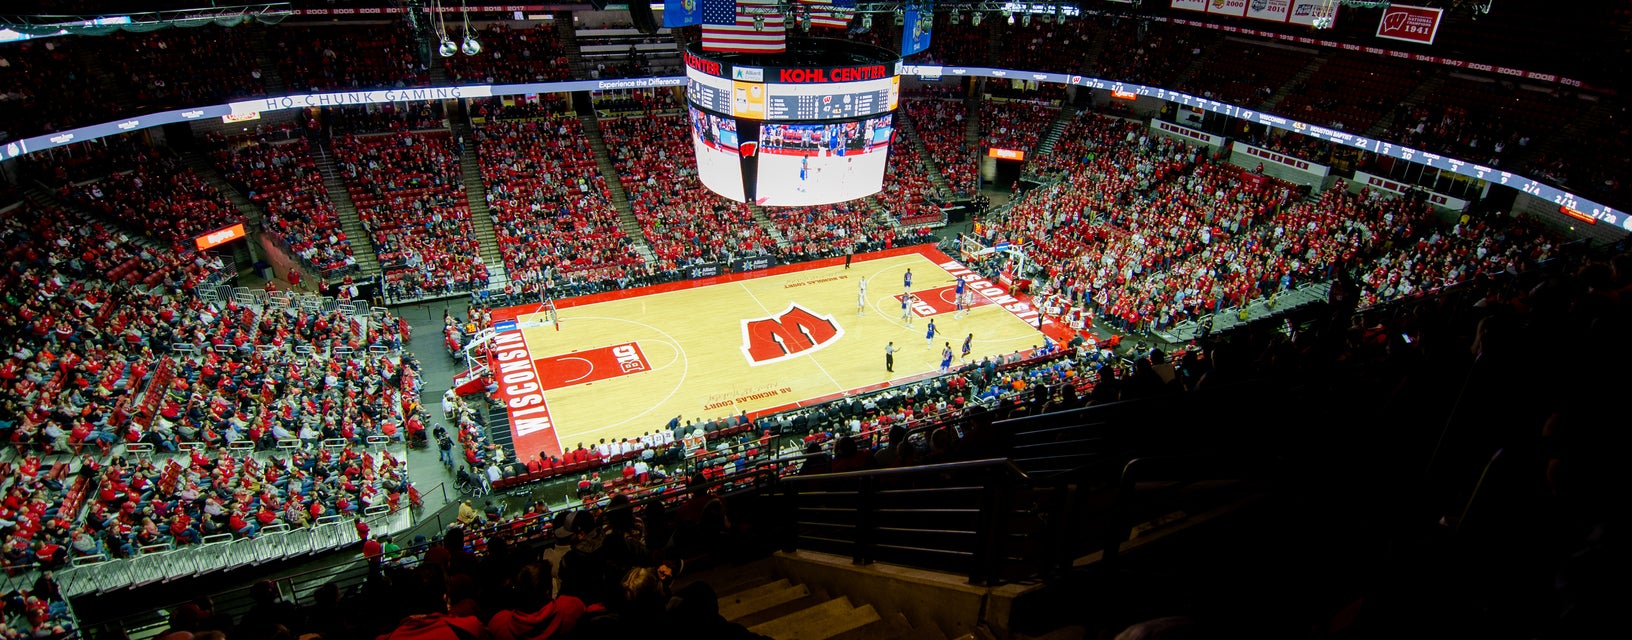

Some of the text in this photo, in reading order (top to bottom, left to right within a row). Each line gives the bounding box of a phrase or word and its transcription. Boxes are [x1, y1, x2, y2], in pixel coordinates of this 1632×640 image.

[1267, 5, 1285, 13] 2014
[1404, 25, 1429, 34] 1941
[779, 65, 886, 83] KOHL CENTER
[1497, 66, 1523, 77] 2003
[599, 80, 635, 89] Experience
[648, 78, 681, 86] Difference
[266, 87, 461, 109] HO-CHUNK GAMING
[1242, 110, 1253, 119] 47
[1355, 137, 1368, 148] 22
[1402, 152, 1412, 160] 10
[1450, 164, 1458, 172] 3
[1476, 170, 1484, 179] 3
[1501, 177, 1508, 185] 9
[1522, 184, 1541, 196] 2/4
[1554, 195, 1577, 210] 2/11
[938, 260, 1054, 328] WISCONSIN
[612, 345, 647, 374] BIG
[495, 332, 551, 437] WISCONSIN
[780, 386, 792, 394] AB
[735, 389, 779, 404] NICHOLAS
[703, 399, 734, 411] COURT
